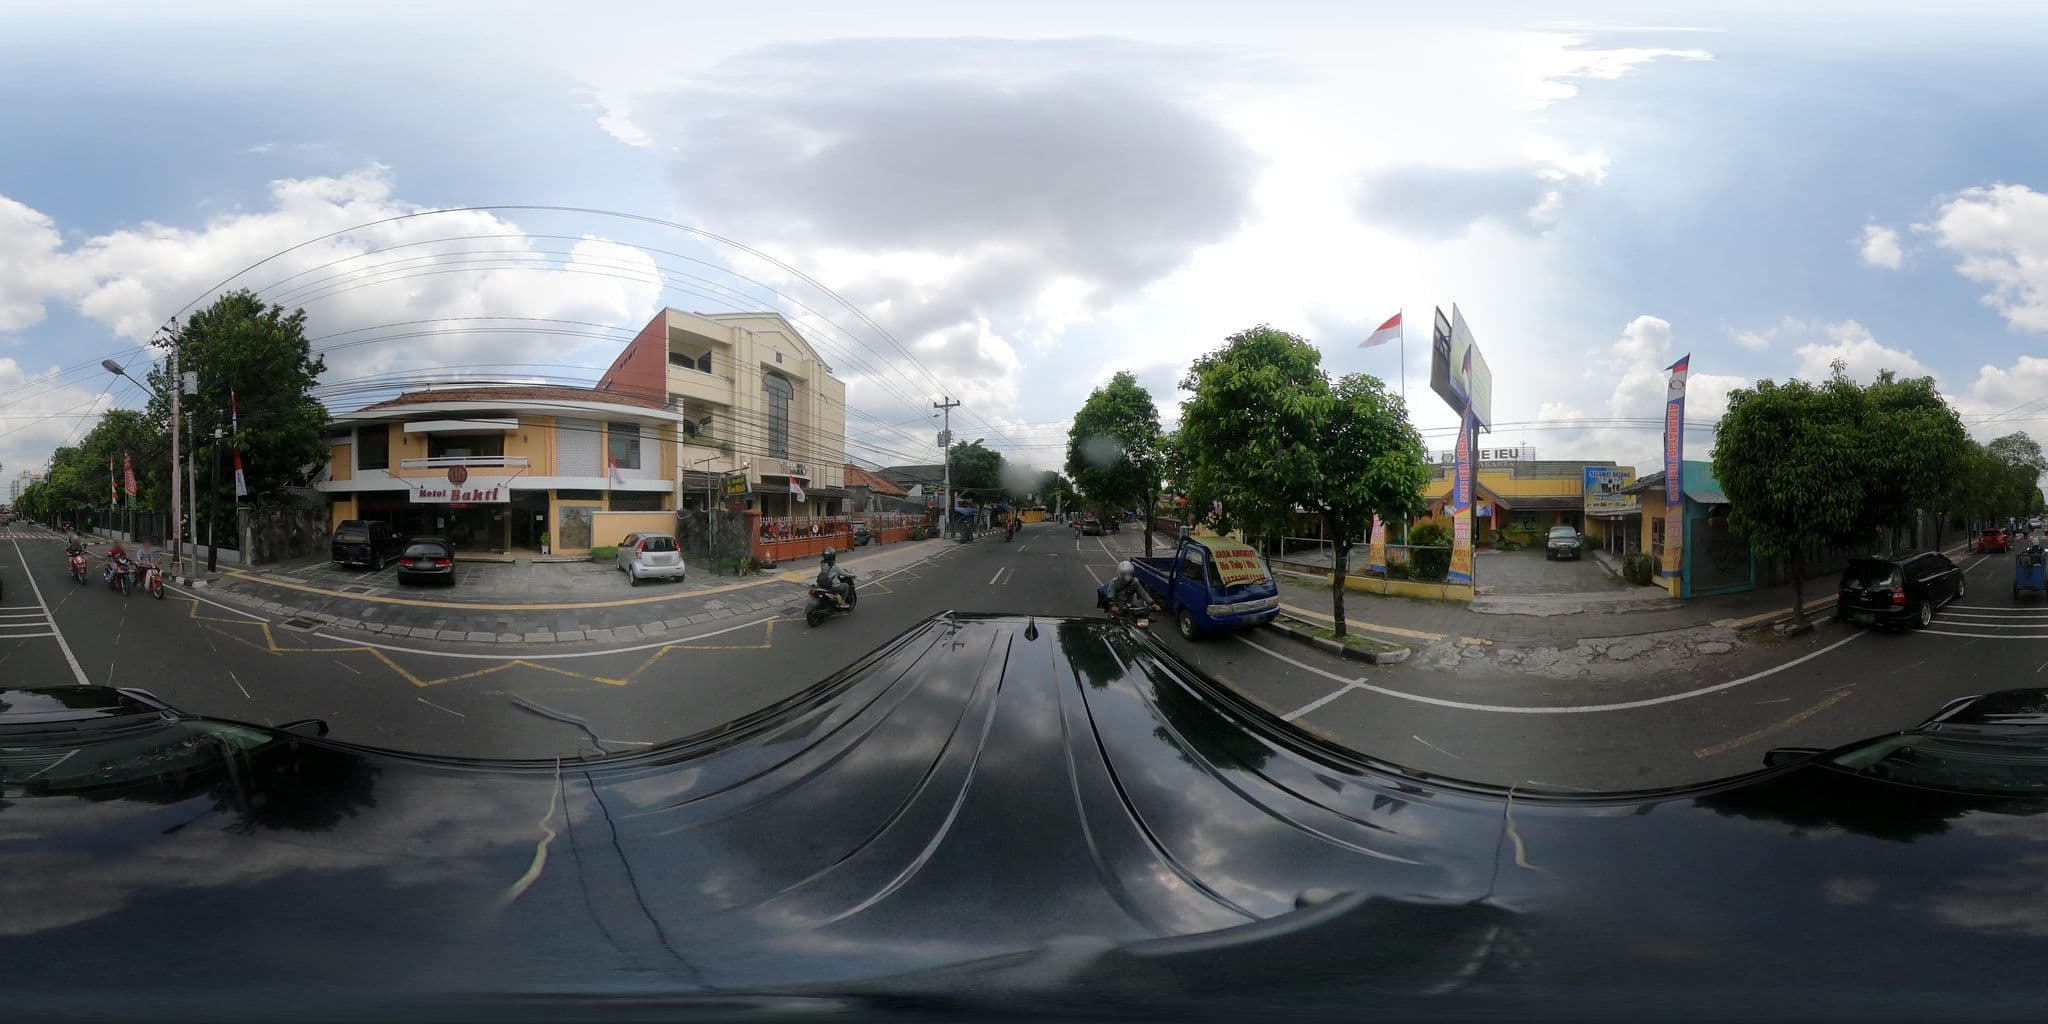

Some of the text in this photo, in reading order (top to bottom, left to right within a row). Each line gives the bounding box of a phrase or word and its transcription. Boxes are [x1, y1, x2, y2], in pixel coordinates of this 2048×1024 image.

[1495, 448, 1519, 460] IEU
[419, 488, 499, 501] Hotel Bakti
